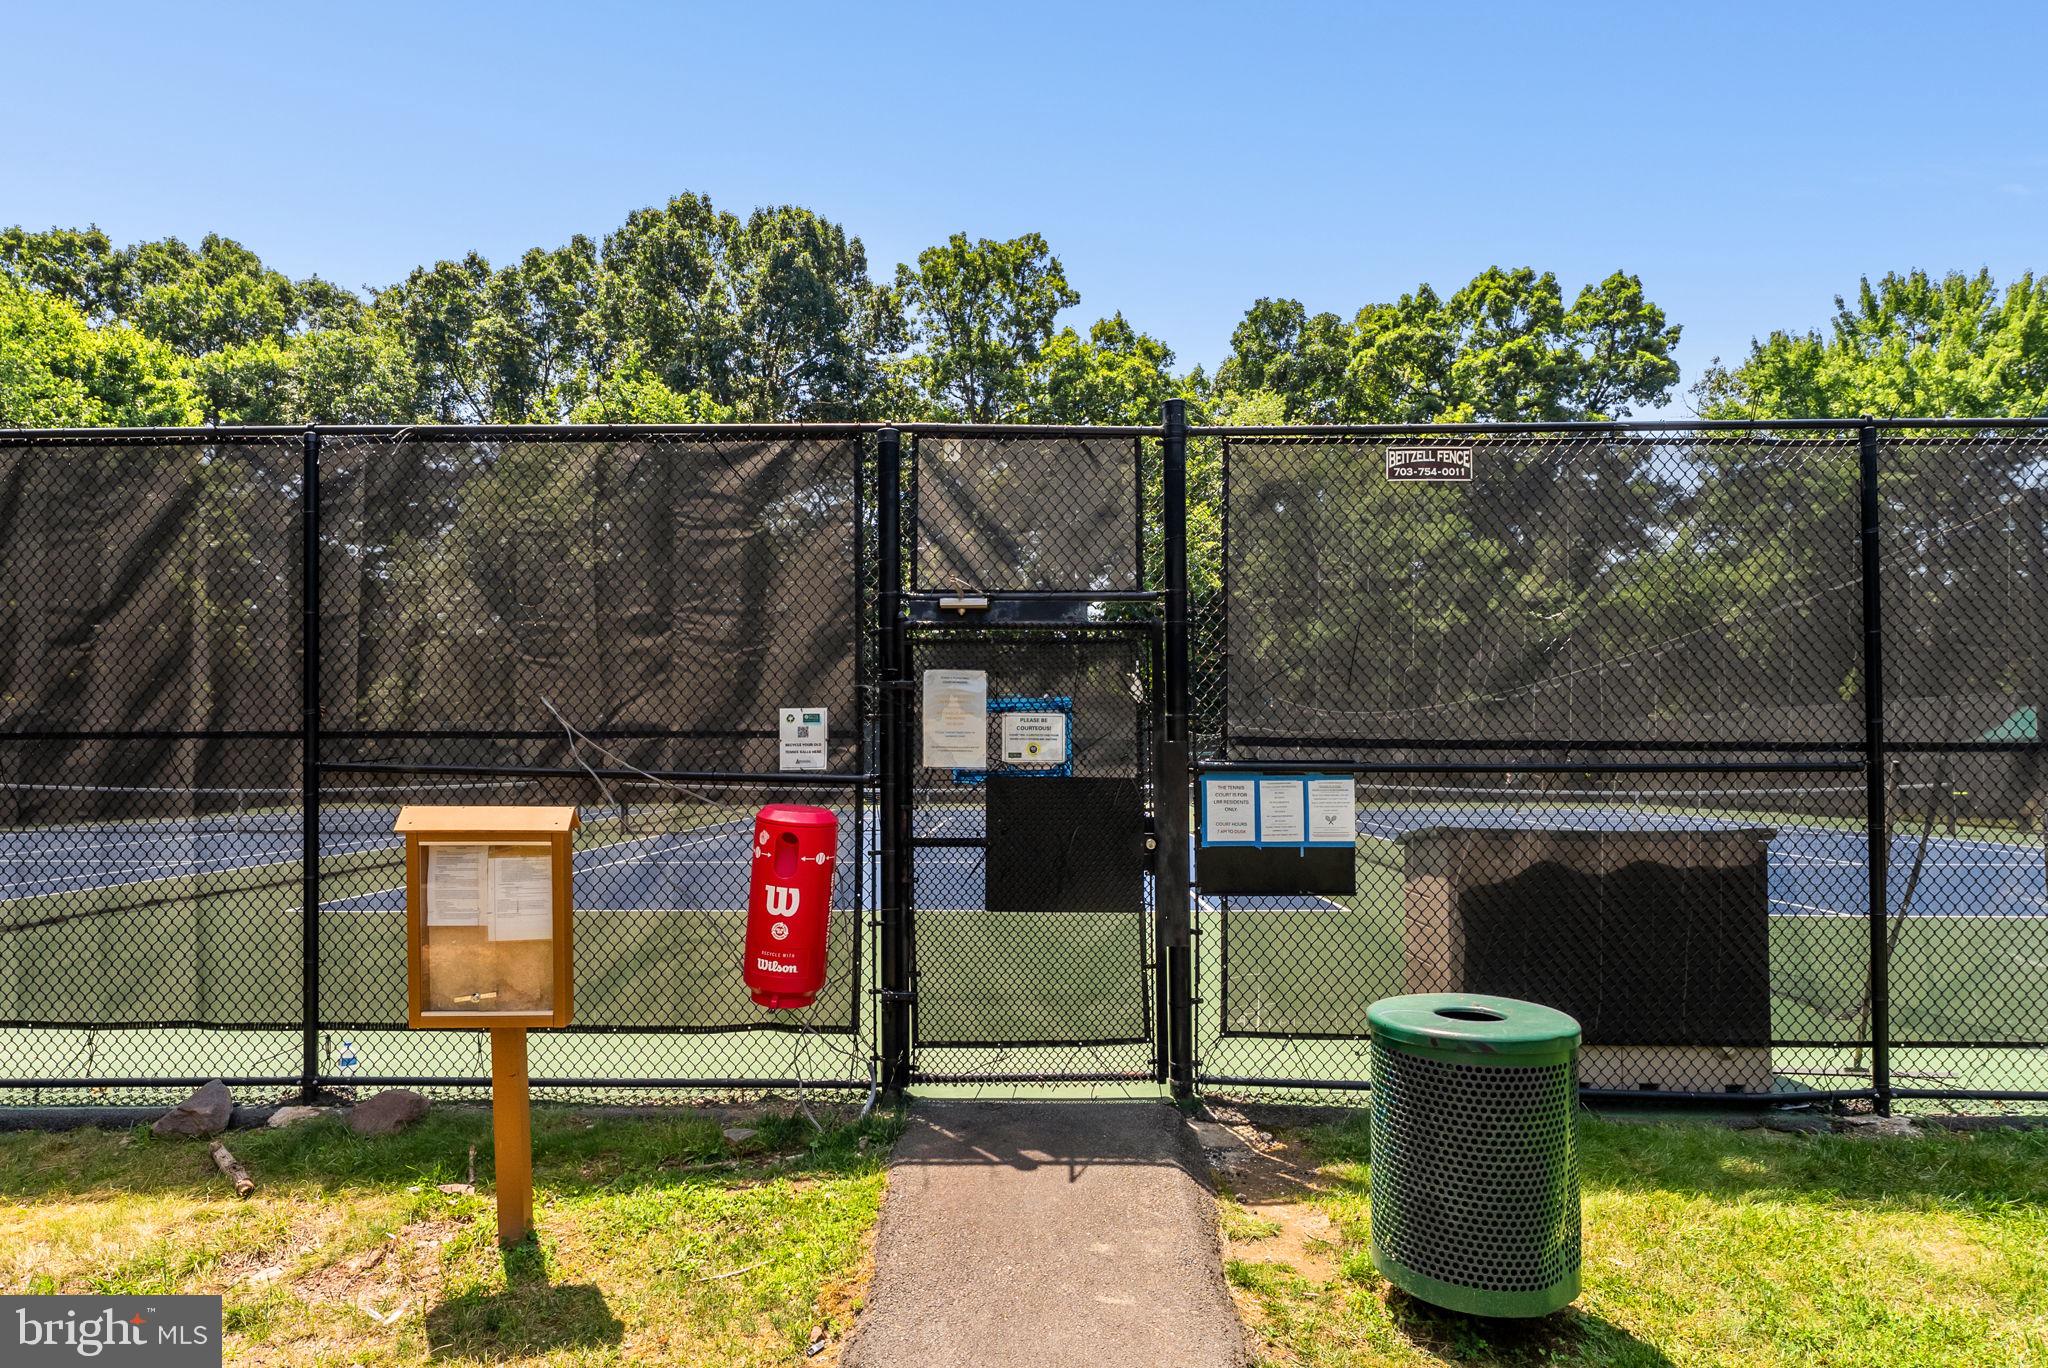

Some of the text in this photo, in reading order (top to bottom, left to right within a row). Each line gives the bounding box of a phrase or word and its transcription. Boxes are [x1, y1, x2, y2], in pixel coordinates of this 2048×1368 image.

[1389, 450, 1470, 468] BEITZELL FENCE
[1393, 467, 1465, 476] 703-754-0011
[761, 950, 781, 958] RECYCLE
[757, 958, 798, 973] Wilson
